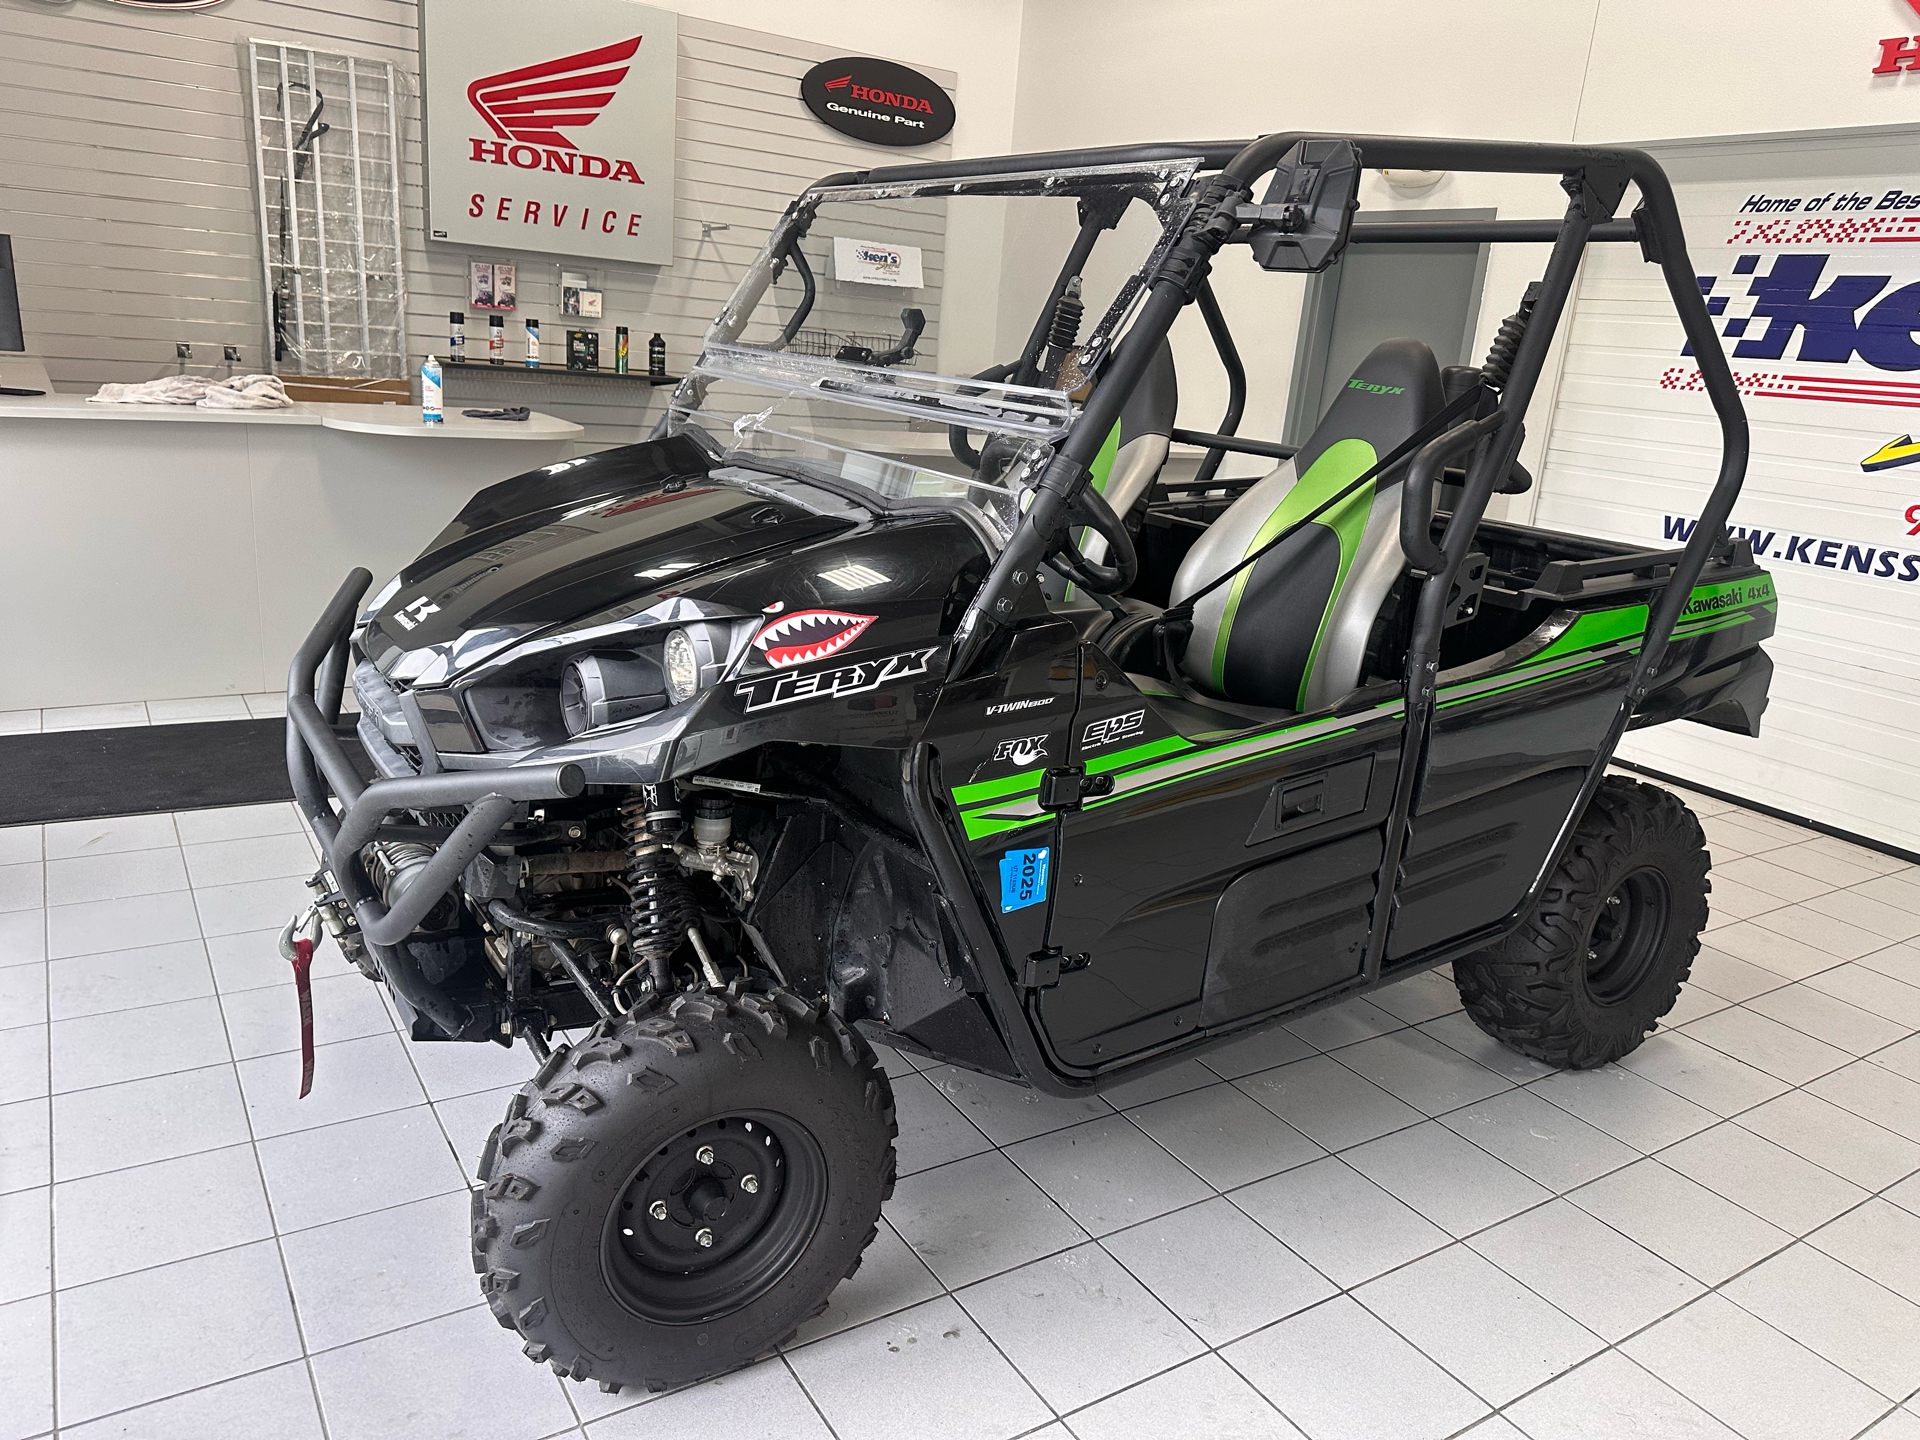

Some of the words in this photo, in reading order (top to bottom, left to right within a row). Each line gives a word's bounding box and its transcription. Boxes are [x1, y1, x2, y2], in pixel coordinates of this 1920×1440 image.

[851, 84, 934, 114] HONDA
[826, 102, 891, 122] Genuine
[894, 115, 925, 129] Part
[468, 141, 645, 185] HONDA
[468, 193, 642, 237] SERVICE
[1739, 194, 1802, 213] Home
[1803, 192, 1836, 212] of
[1831, 191, 1873, 211] the
[1682, 586, 1743, 616] Kawasaki
[1747, 583, 1770, 600] 4x4
[735, 646, 941, 713] TERYX
[1082, 709, 1145, 741] EPS
[994, 734, 1049, 761] FOX
[1019, 853, 1036, 901] 2025
